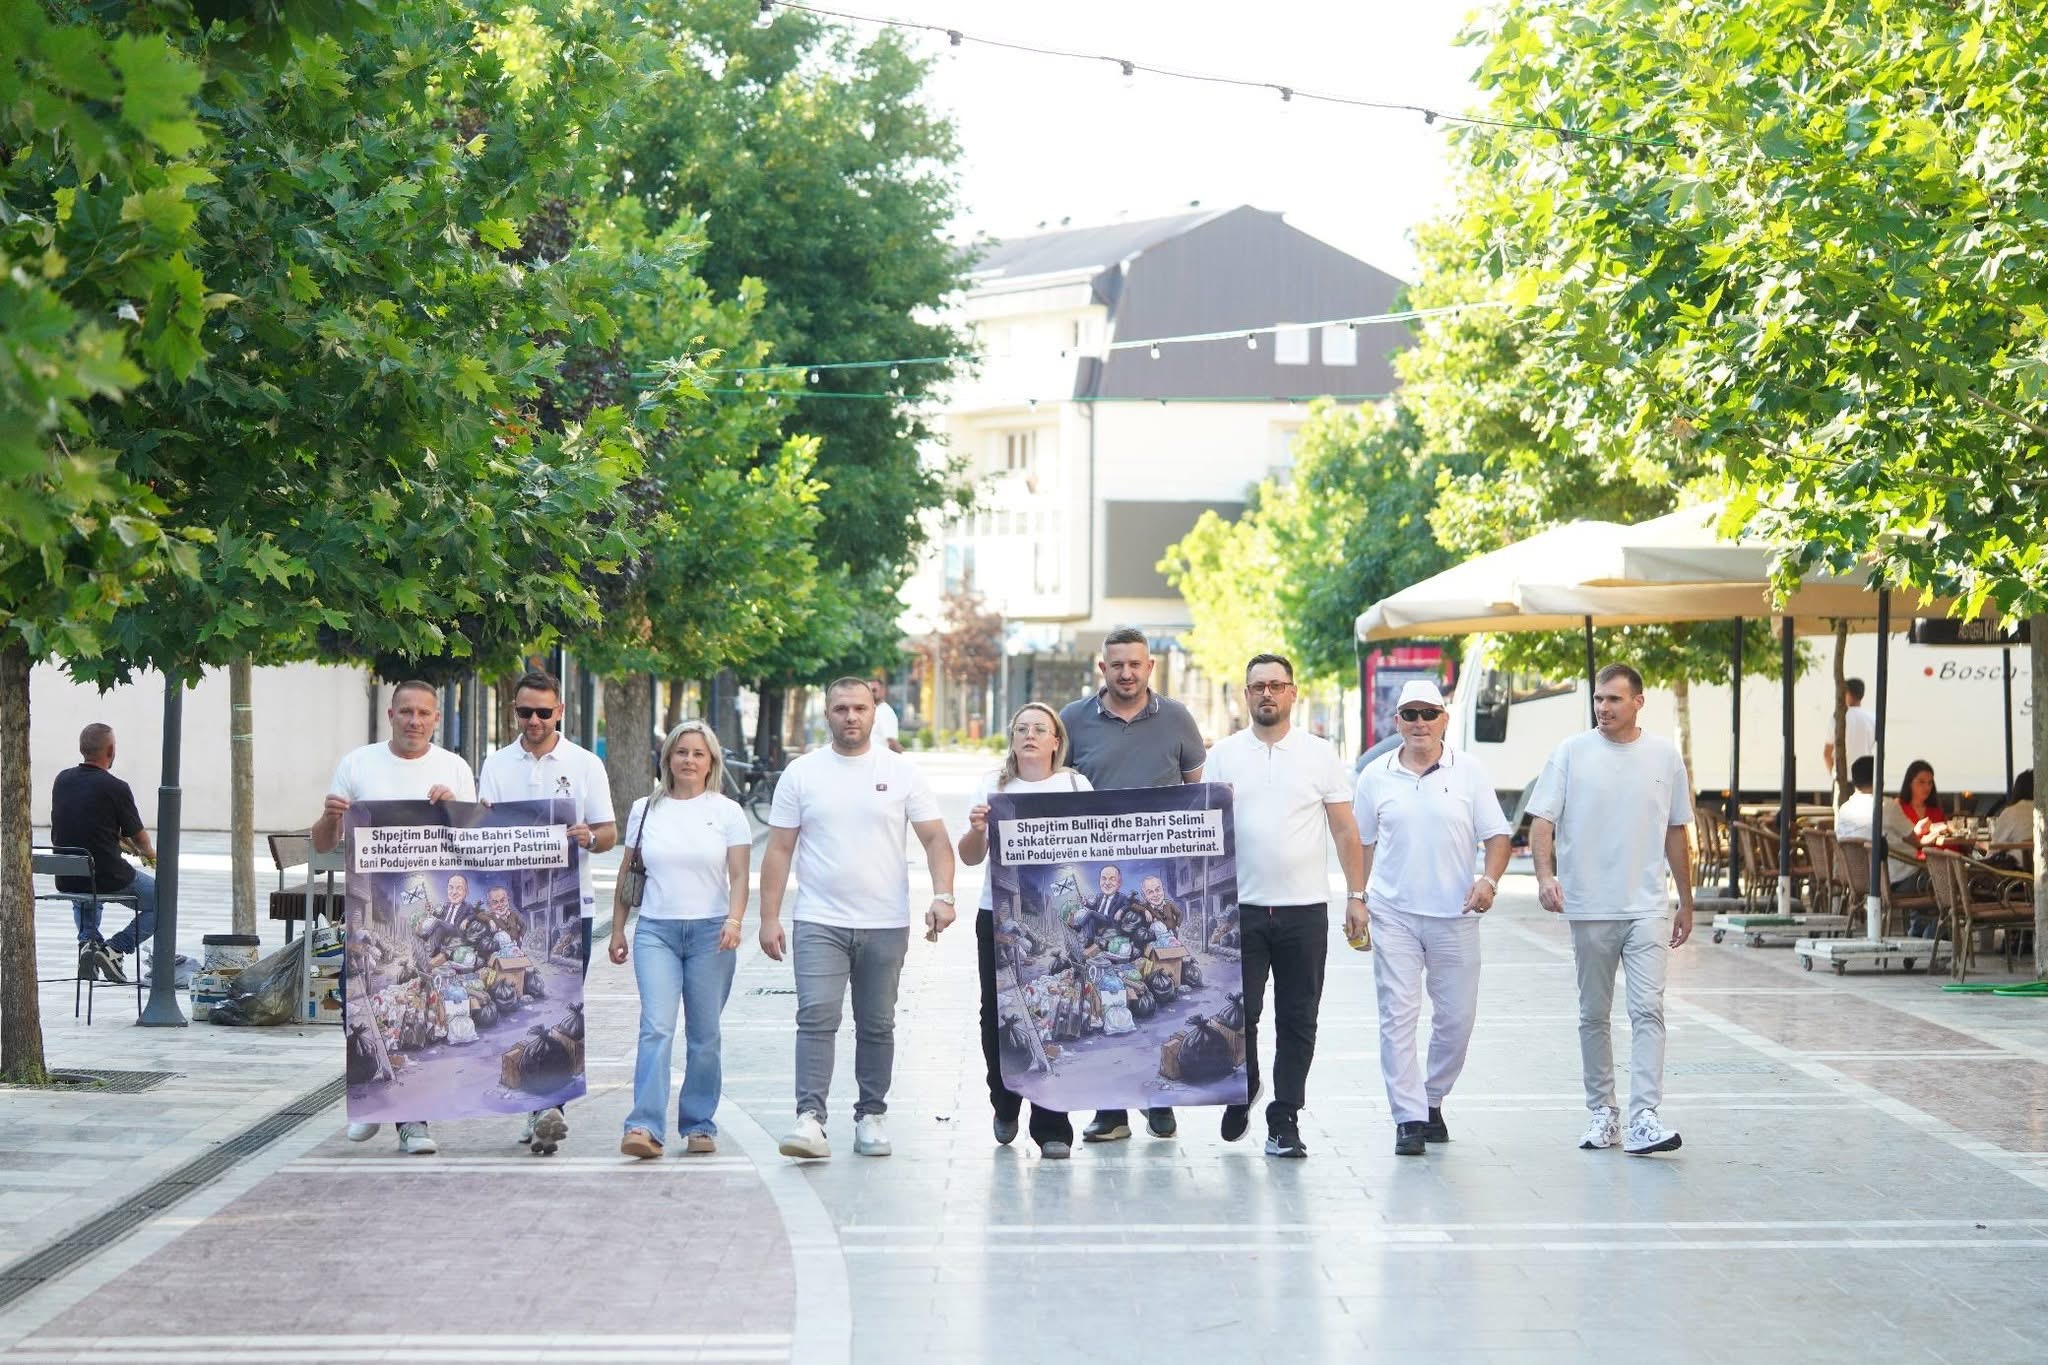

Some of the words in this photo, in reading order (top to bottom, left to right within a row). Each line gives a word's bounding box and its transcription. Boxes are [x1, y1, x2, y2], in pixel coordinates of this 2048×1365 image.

[1017, 822, 1069, 834] Shpejtim
[1072, 819, 1109, 831] Bulliqi
[1111, 818, 1132, 828] dhe
[1135, 816, 1166, 827] Bahri
[1168, 814, 1204, 825] Selimi
[372, 830, 421, 842] Shpejtim
[424, 829, 457, 842] Bulliqi
[459, 832, 479, 841] dhe
[482, 830, 512, 841] Bahri
[515, 828, 549, 839] Selimi
[1008, 839, 1014, 847] e
[1017, 834, 1087, 847] shkatërruan
[1091, 830, 1164, 844] Ndërmarrjen
[1167, 827, 1215, 839] Pastrimi
[362, 847, 368, 855] e
[371, 843, 437, 854] shkatërruan
[441, 842, 510, 856] Ndërmarrjen
[513, 842, 560, 852] Pastrimi
[1006, 851, 1025, 861] tani
[1027, 848, 1079, 860] Podujevën
[1082, 849, 1087, 857] e
[1090, 846, 1114, 857] kanë
[1117, 845, 1158, 855] mbuluar
[1160, 842, 1219, 854] mbeturinat.
[360, 858, 378, 868] tani
[380, 858, 429, 870] Podujevën
[439, 856, 462, 866] kanë
[464, 857, 504, 867] mbuluar
[507, 855, 563, 866] mbeturinat.
